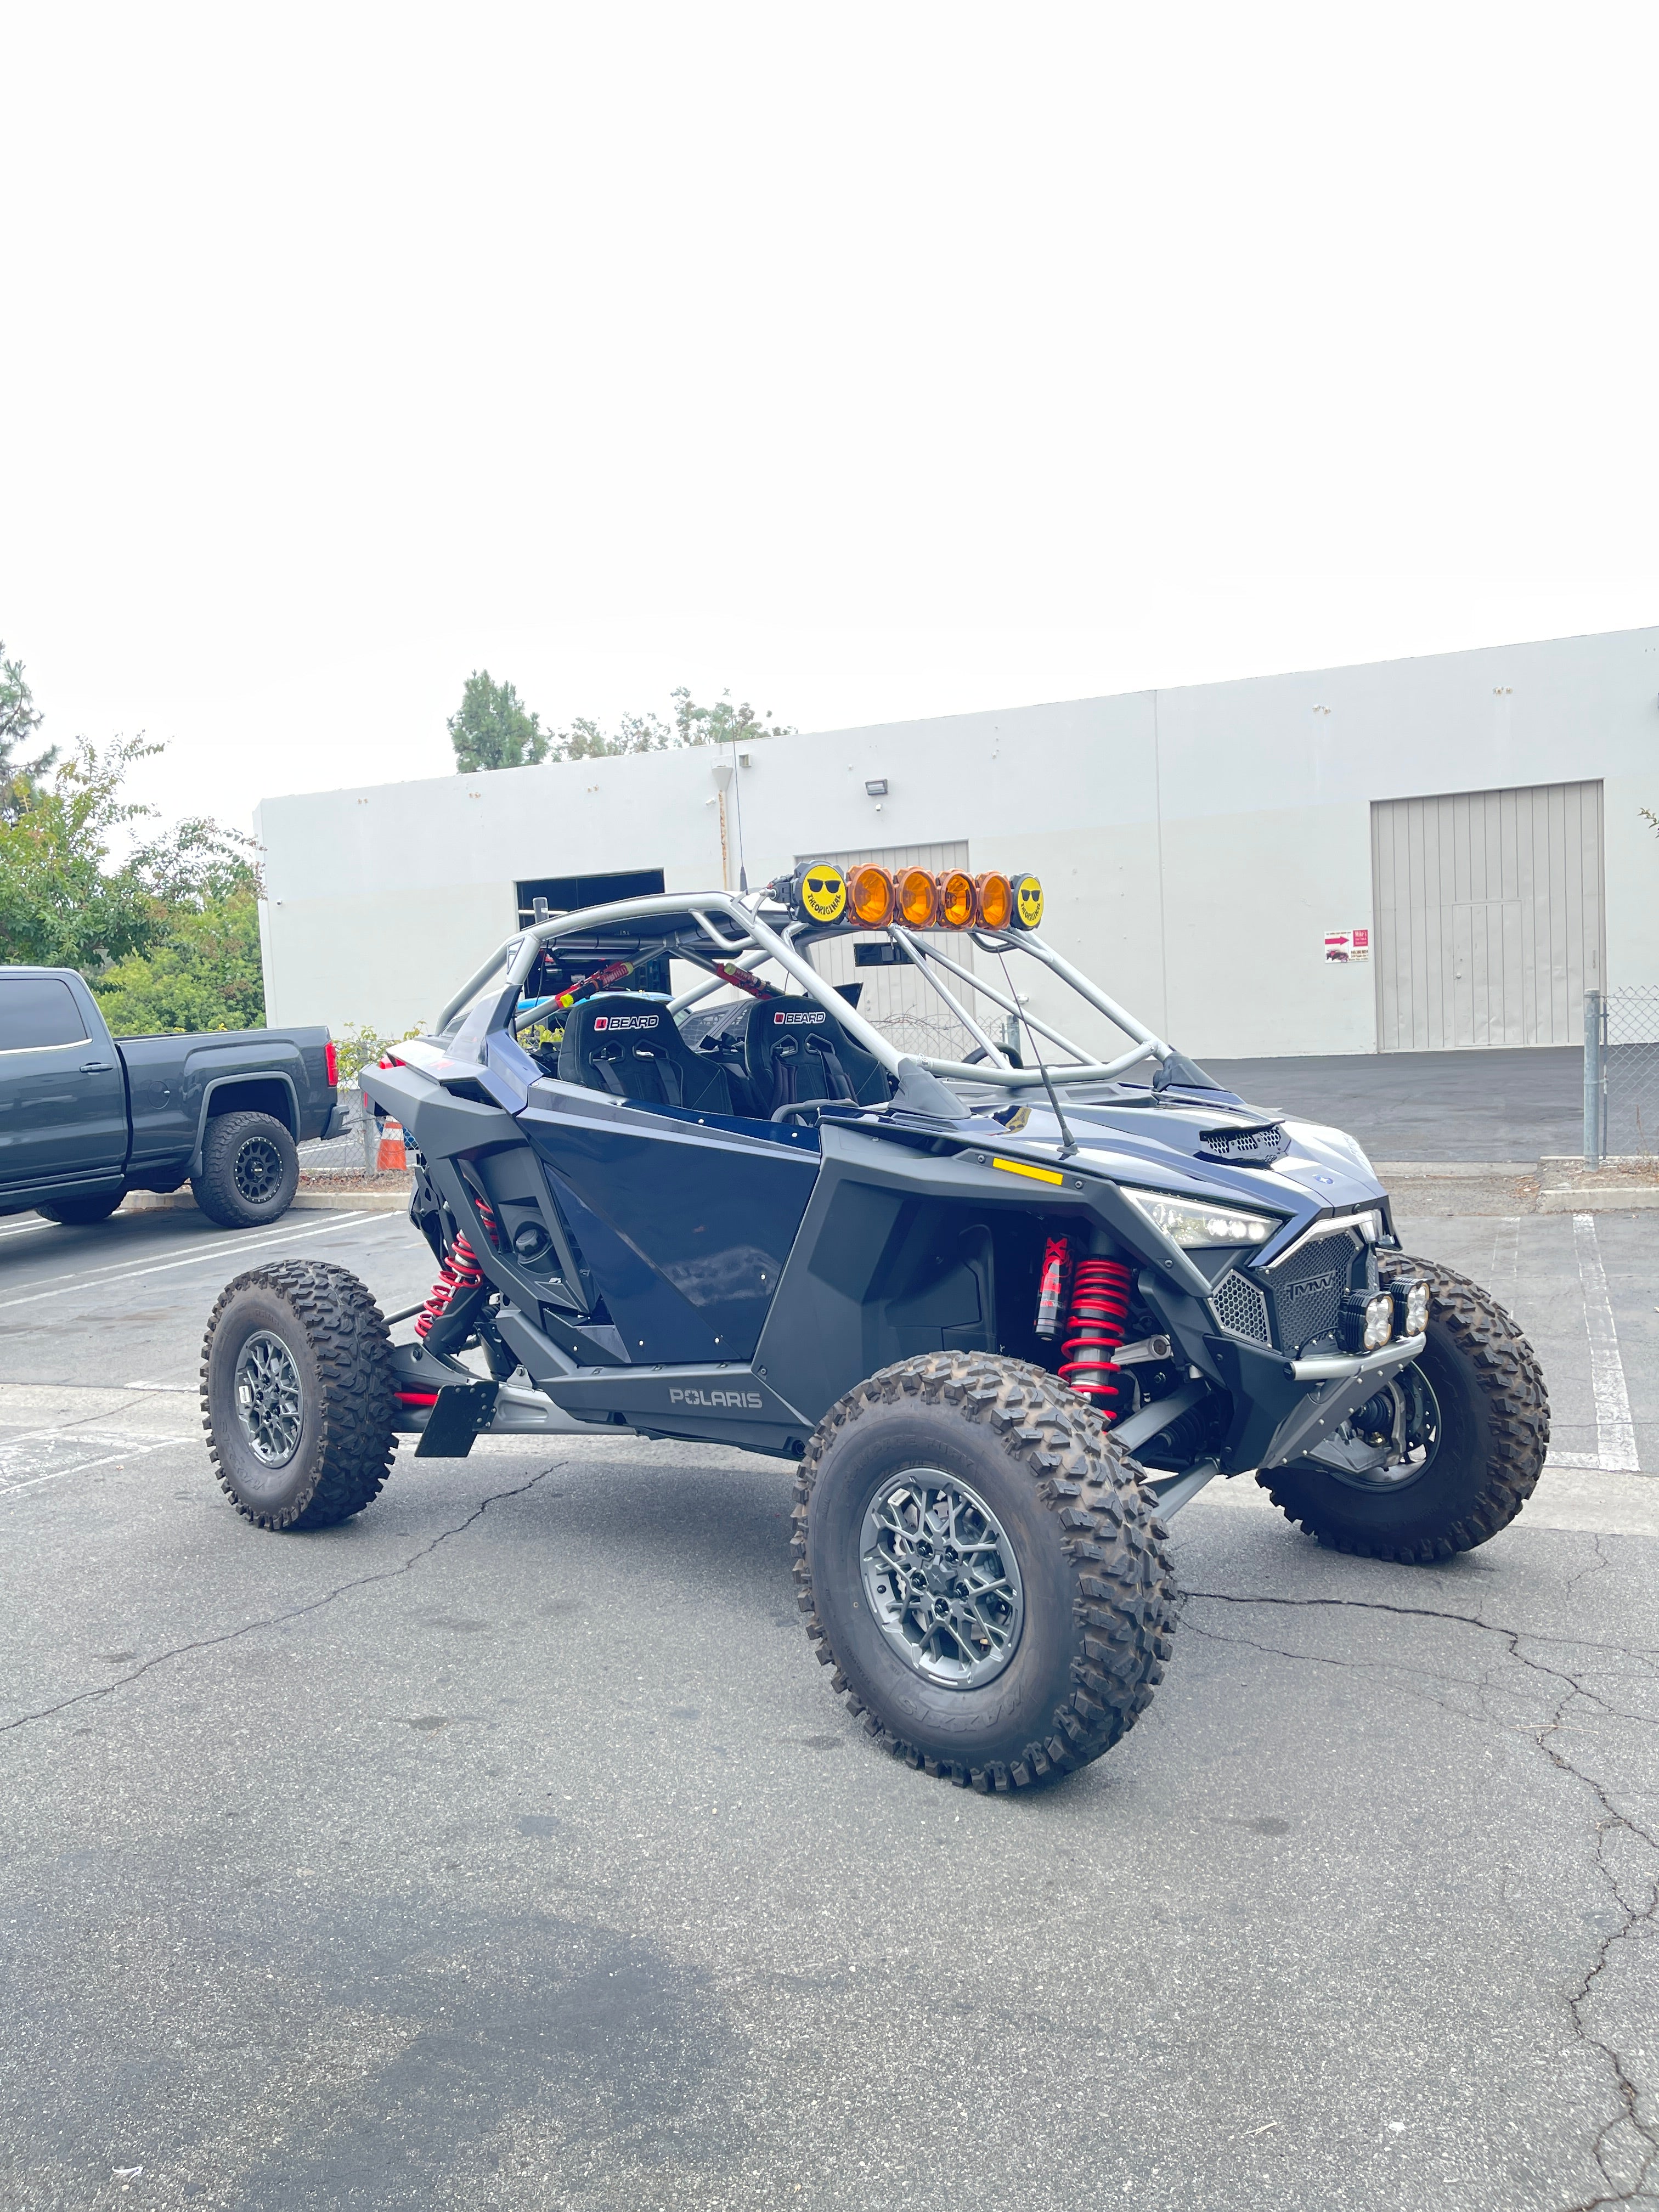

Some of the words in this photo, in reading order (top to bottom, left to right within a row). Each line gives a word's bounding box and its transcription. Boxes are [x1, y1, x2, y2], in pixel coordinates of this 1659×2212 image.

[608, 1015, 659, 1030] BEARD
[785, 1012, 826, 1024] BEARD
[1040, 1237, 1069, 1294] FOX
[669, 1387, 763, 1409] POLARIS
